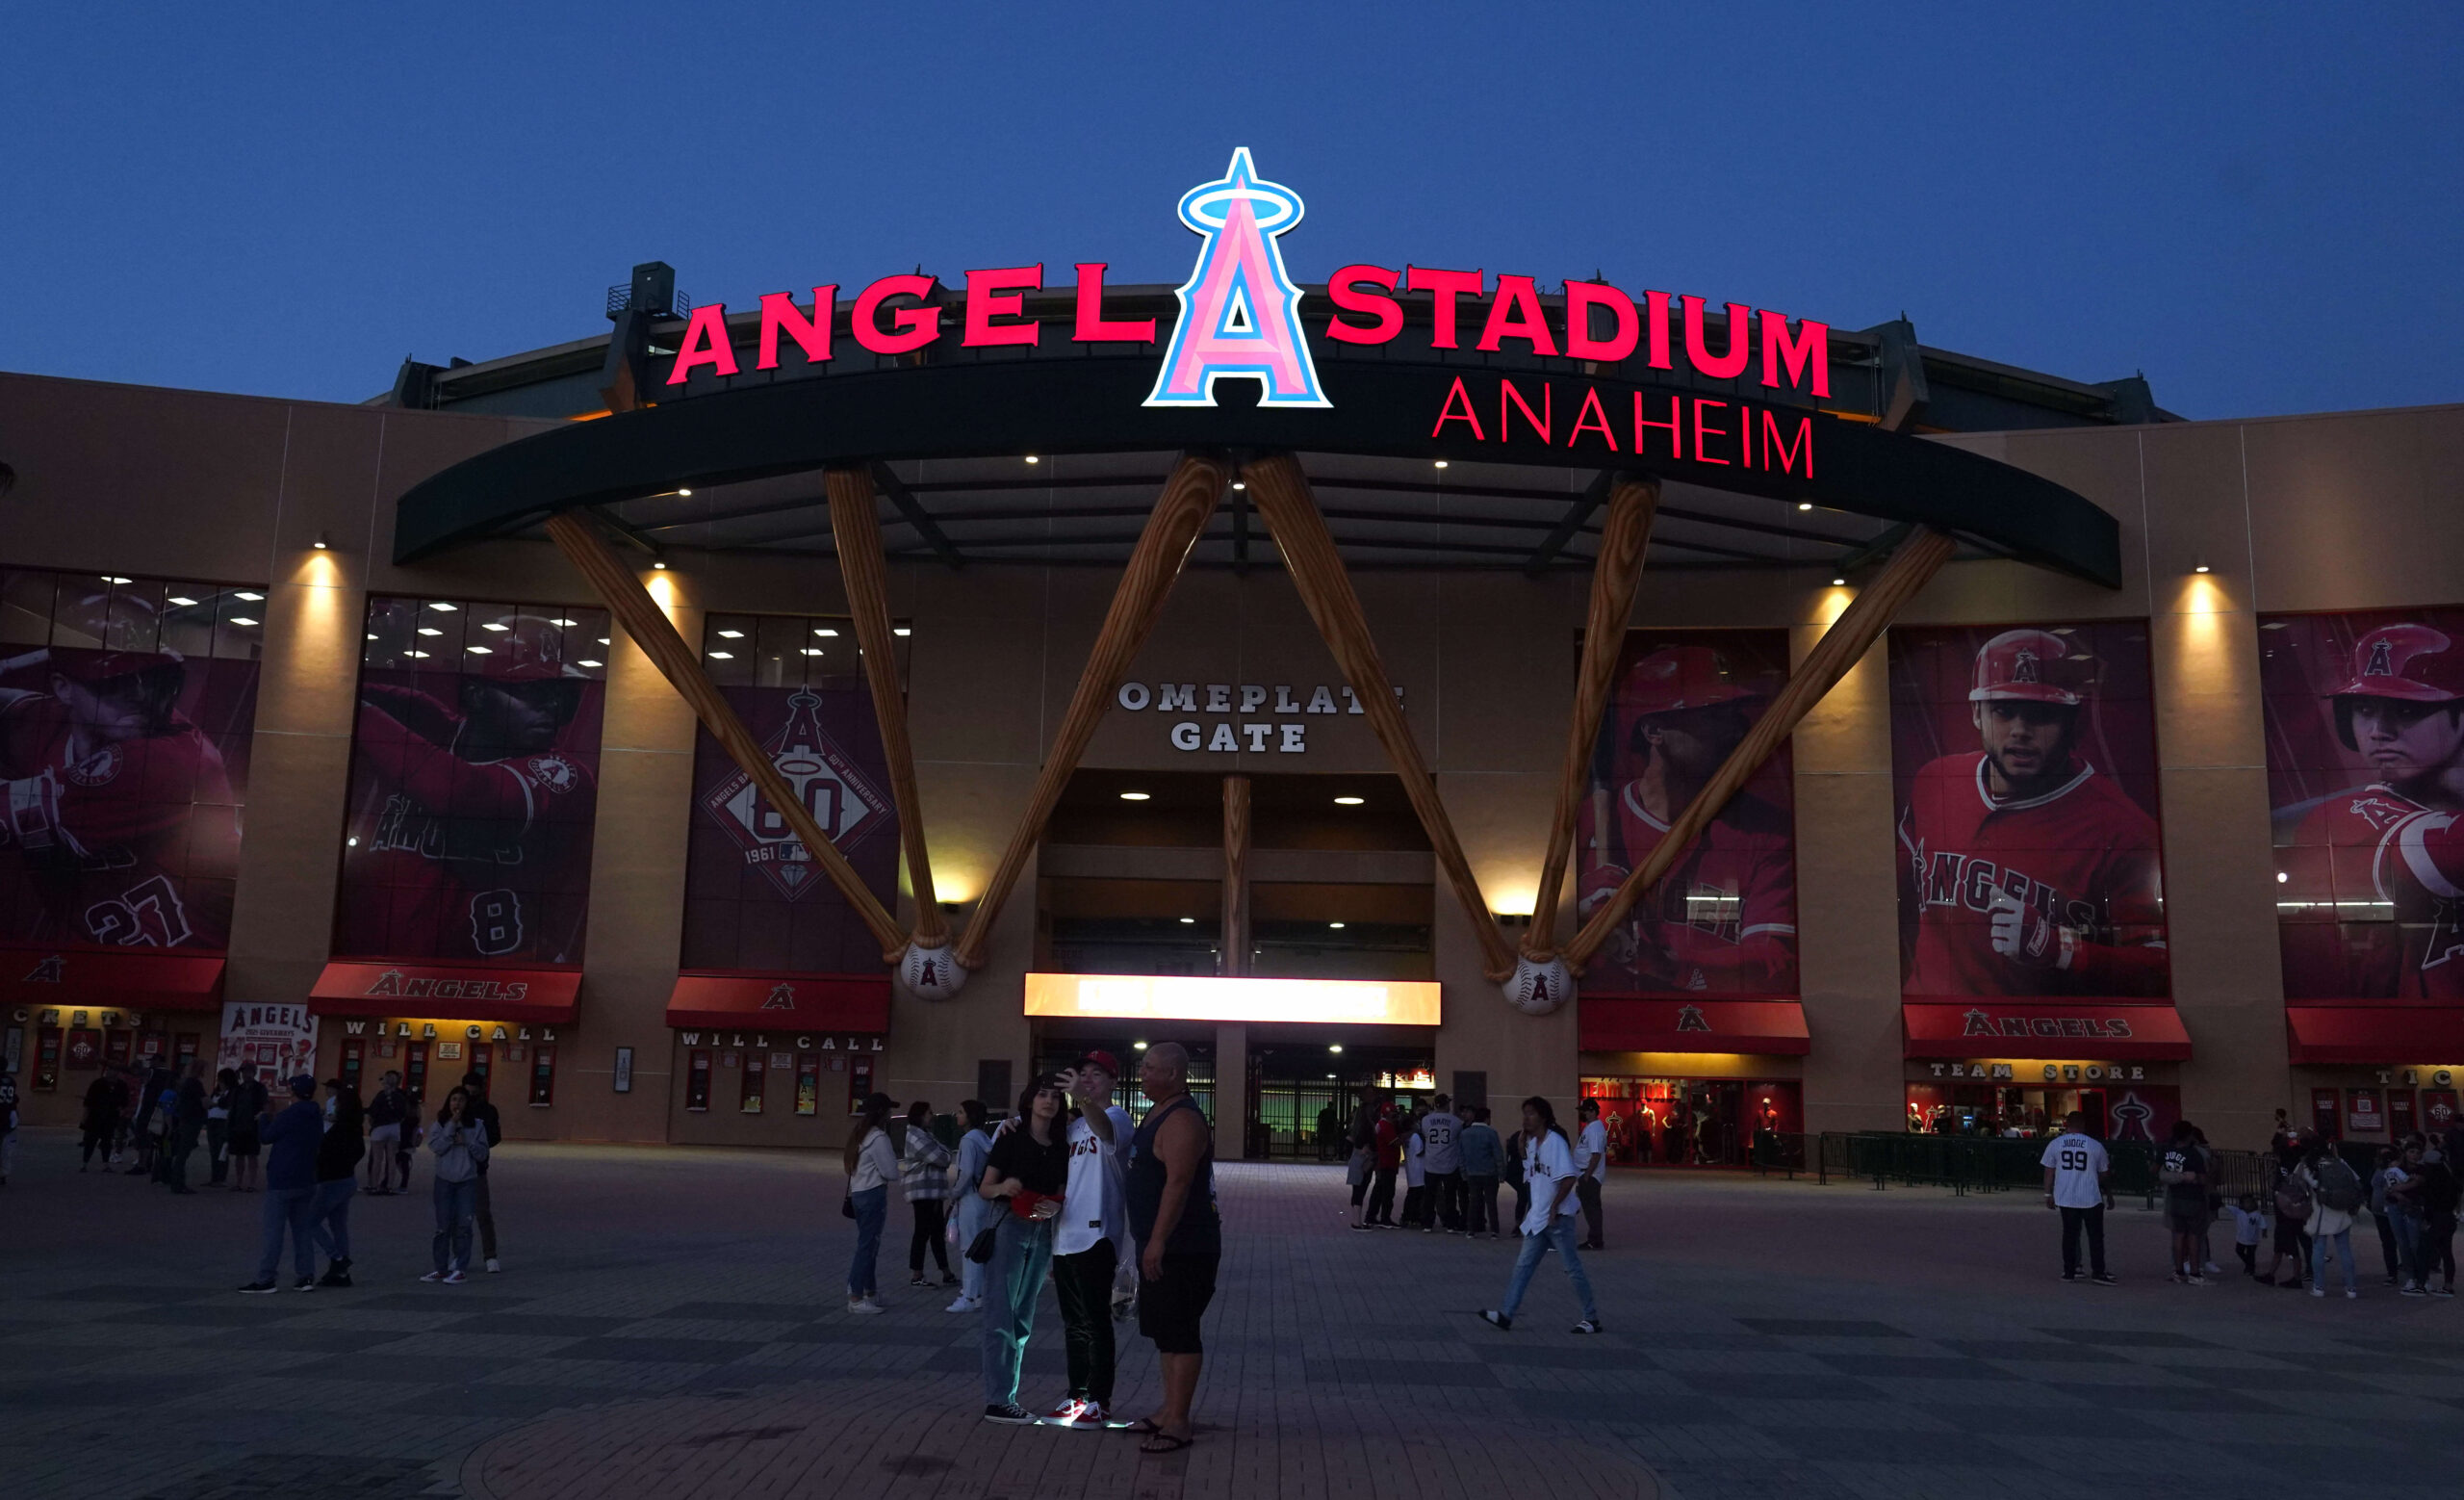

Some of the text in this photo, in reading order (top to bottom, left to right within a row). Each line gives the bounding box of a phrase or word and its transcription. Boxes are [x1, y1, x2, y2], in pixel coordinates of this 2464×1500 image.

[1325, 263, 1832, 400] STADIUM
[1432, 375, 1814, 480] ANAHEIM
[1169, 721, 1306, 754] GATE
[708, 782, 740, 810] ANGELS
[841, 768, 888, 815] ANNIVERSARY
[745, 845, 776, 865] 1961
[470, 888, 525, 956] 8
[365, 969, 527, 1001] ANGELS
[230, 1005, 313, 1034] ANGELS
[346, 1020, 555, 1042] WILL CALL
[1963, 1008, 2133, 1039] ANGELS
[681, 1031, 884, 1051] WILL CALL
[1930, 1062, 2145, 1080] TEAM STORE
[1580, 1081, 1624, 1099] TEAM
[1429, 1128, 1450, 1145] 23
[2063, 1138, 2087, 1149] JUDGE
[2061, 1151, 2088, 1171] 99
